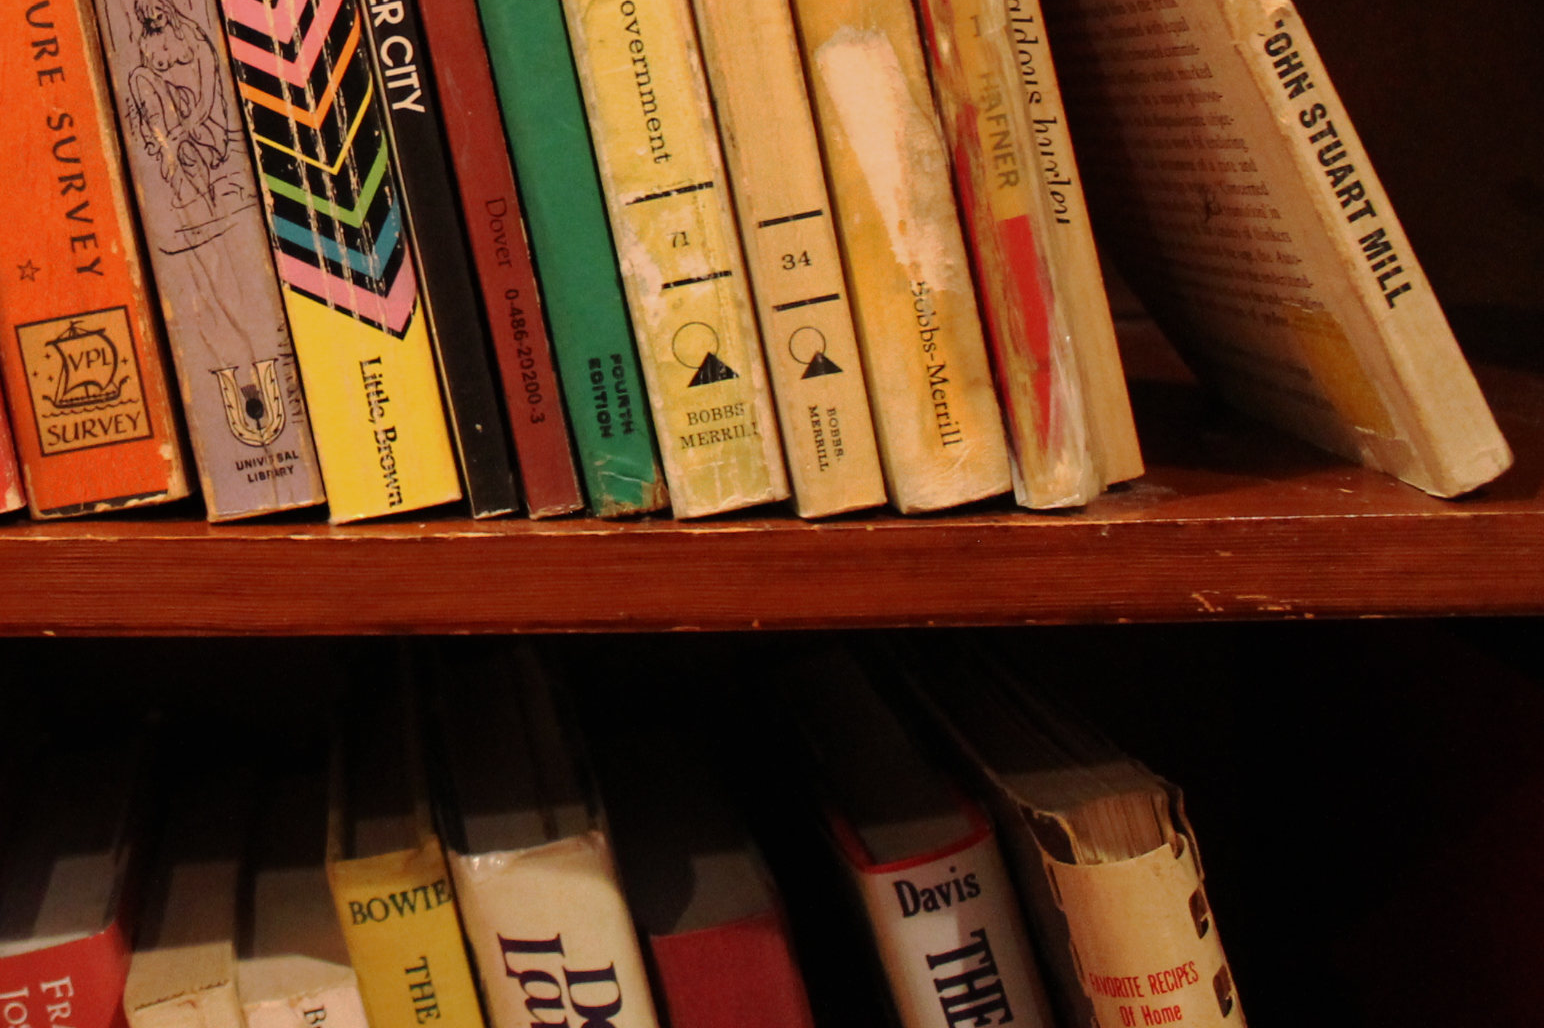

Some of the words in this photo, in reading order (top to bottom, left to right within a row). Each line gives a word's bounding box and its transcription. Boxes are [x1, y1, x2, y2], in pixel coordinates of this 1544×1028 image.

[376, 31, 426, 119] CITY
[45, 111, 104, 282] SURVEY
[1296, 101, 1377, 228] STUART
[1355, 226, 1416, 310] MILL
[482, 196, 512, 270] Dover
[781, 250, 812, 271] 34
[68, 347, 112, 372] VPL
[502, 288, 546, 425] 0-486-20200-3
[584, 357, 615, 440] EDITION
[605, 352, 636, 435] FOURTH
[686, 402, 745, 426] BOBBS
[47, 412, 141, 446] SURVEY
[808, 404, 830, 472] MERRILL
[372, 426, 404, 509] Brown
[349, 879, 454, 925] BOWIE
[893, 866, 982, 918] Davis
[404, 955, 442, 1025] THE
[1148, 960, 1200, 996] RECIPES
[1143, 1003, 1182, 1026] Home
